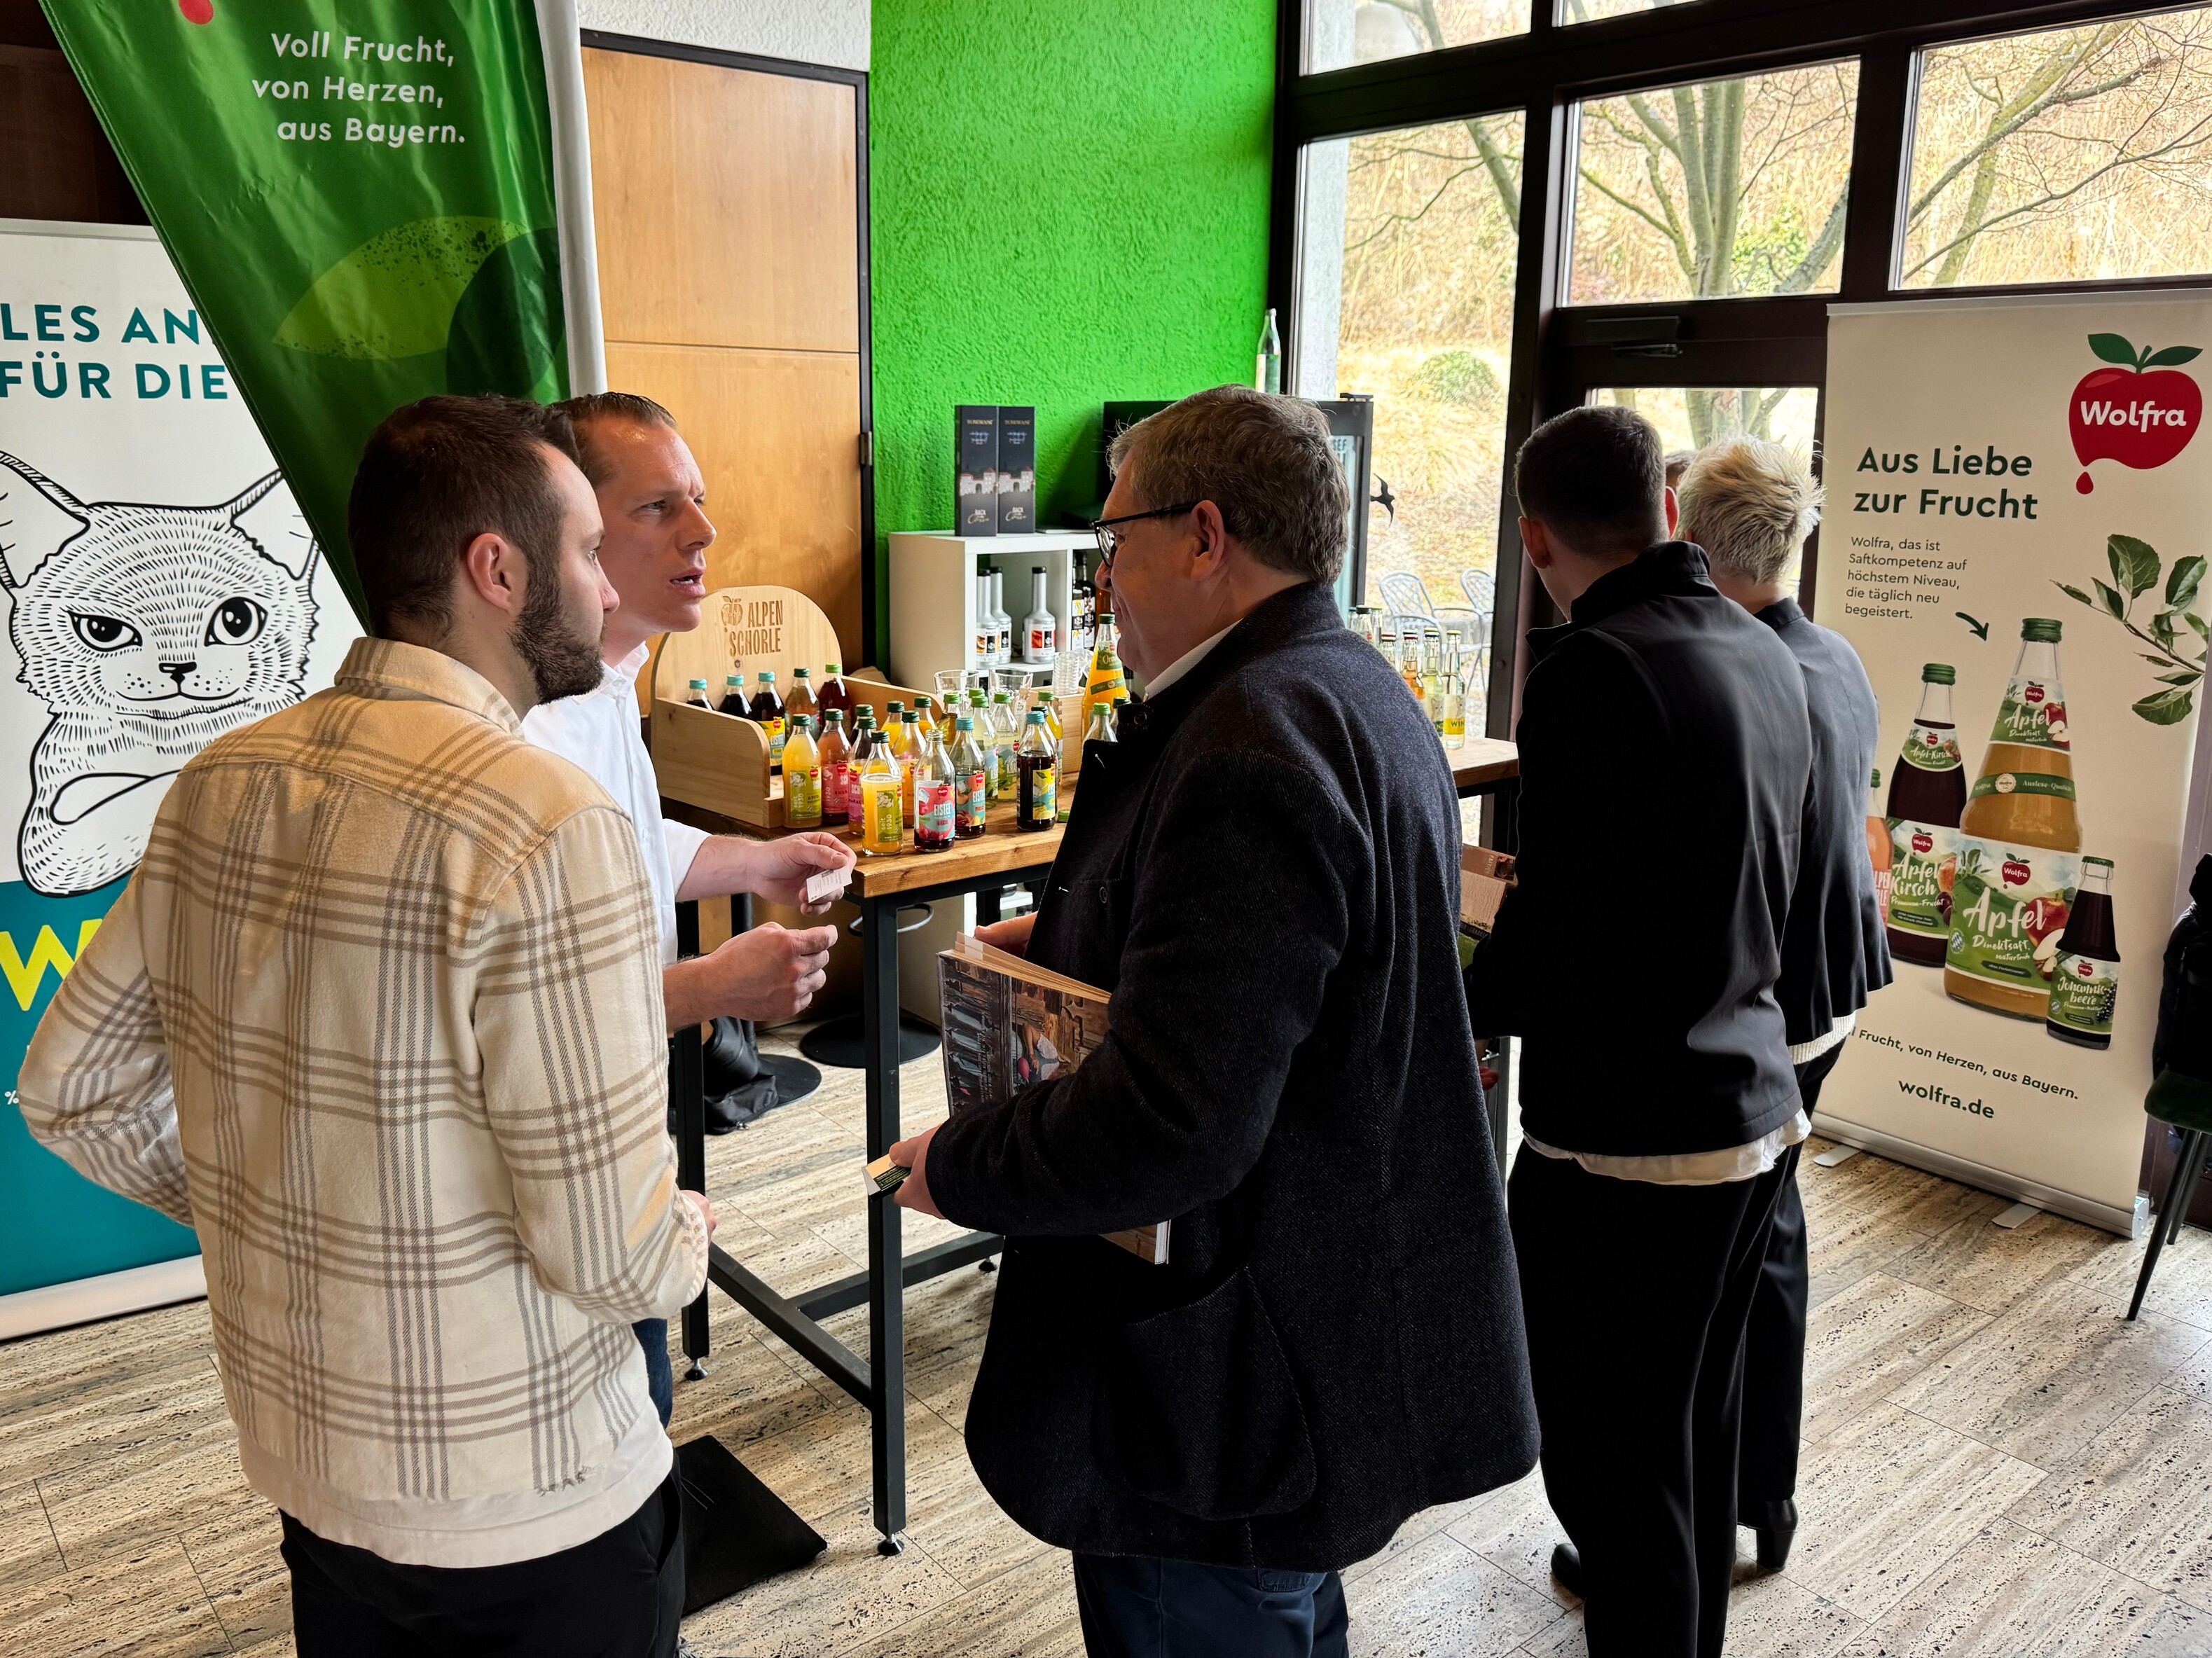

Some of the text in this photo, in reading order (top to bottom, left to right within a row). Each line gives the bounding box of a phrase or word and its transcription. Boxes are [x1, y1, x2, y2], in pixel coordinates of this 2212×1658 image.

[271, 31, 454, 67] Voll Frucht,
[252, 76, 443, 108] von Herzen,
[277, 118, 465, 148] aus Bayern.
[0, 303, 205, 345] LES AN
[0, 350, 228, 399] FÜR DIE
[2080, 400, 2187, 433] Wolfra
[1856, 444, 2032, 476] Aus Liebe
[1853, 488, 2038, 520] zur Frucht
[1851, 537, 1940, 551] Wolfra, das ist
[1848, 553, 1968, 570] Saftkompetenz auf
[1847, 569, 1961, 590] höchstem Niveau,
[1846, 586, 1940, 604] die täglich neu
[747, 600, 783, 628] ALPEN
[1844, 603, 1913, 619] begeistert.
[729, 628, 781, 657] SCHORLE
[2004, 703, 2052, 730] Apfel
[934, 802, 951, 816] EISTEE
[1892, 852, 1939, 882] Apfel
[2003, 867, 2028, 878] Wolfra
[1890, 876, 1937, 896] Kirsch
[1963, 887, 2047, 938] Apfel
[2070, 992, 2096, 1004] beere
[1858, 1029, 1904, 1052] Frucht,
[1908, 1044, 1933, 1058] von
[1936, 1051, 1988, 1076] Herzen,
[1992, 1068, 2018, 1082] aus
[2021, 1075, 2078, 1100] Bayern.
[1898, 1079, 1995, 1119] wolfra.de
